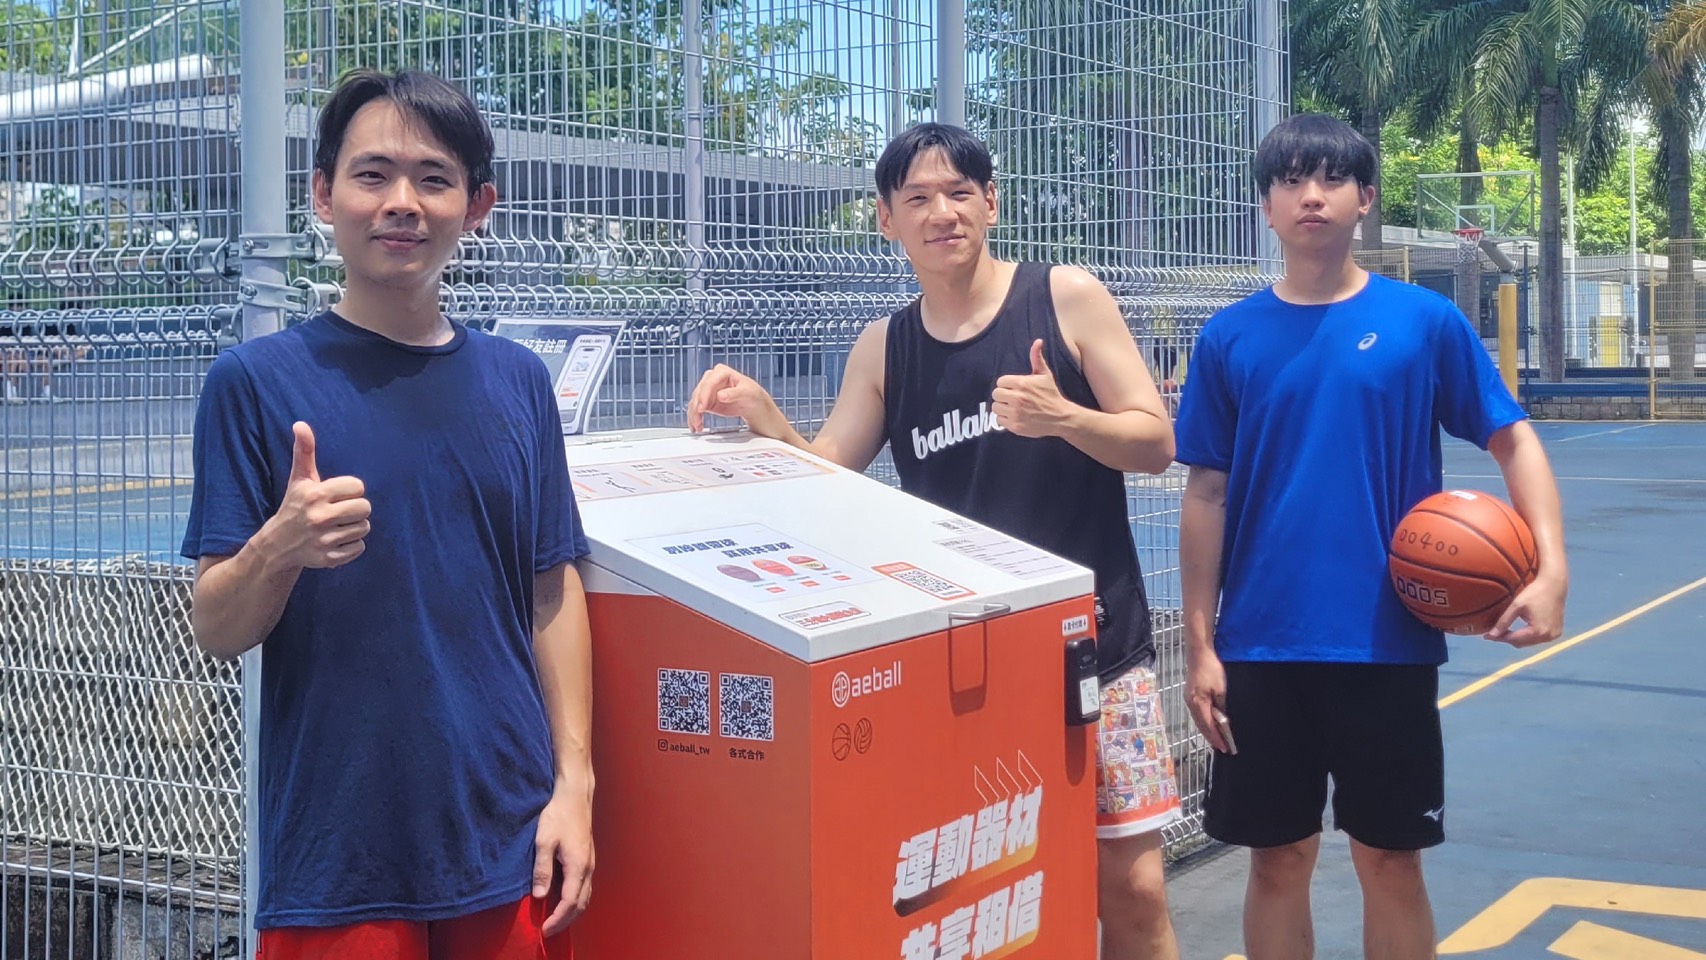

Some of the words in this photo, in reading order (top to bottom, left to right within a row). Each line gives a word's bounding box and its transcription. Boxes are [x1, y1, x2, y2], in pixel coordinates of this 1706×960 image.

[512, 338, 568, 354] 好友註冊
[1400, 528, 1459, 556] 00400
[851, 660, 901, 698] aeball
[669, 743, 710, 756] aeball_tw
[729, 747, 765, 761] 各式合作
[893, 784, 1043, 906] 運動器材
